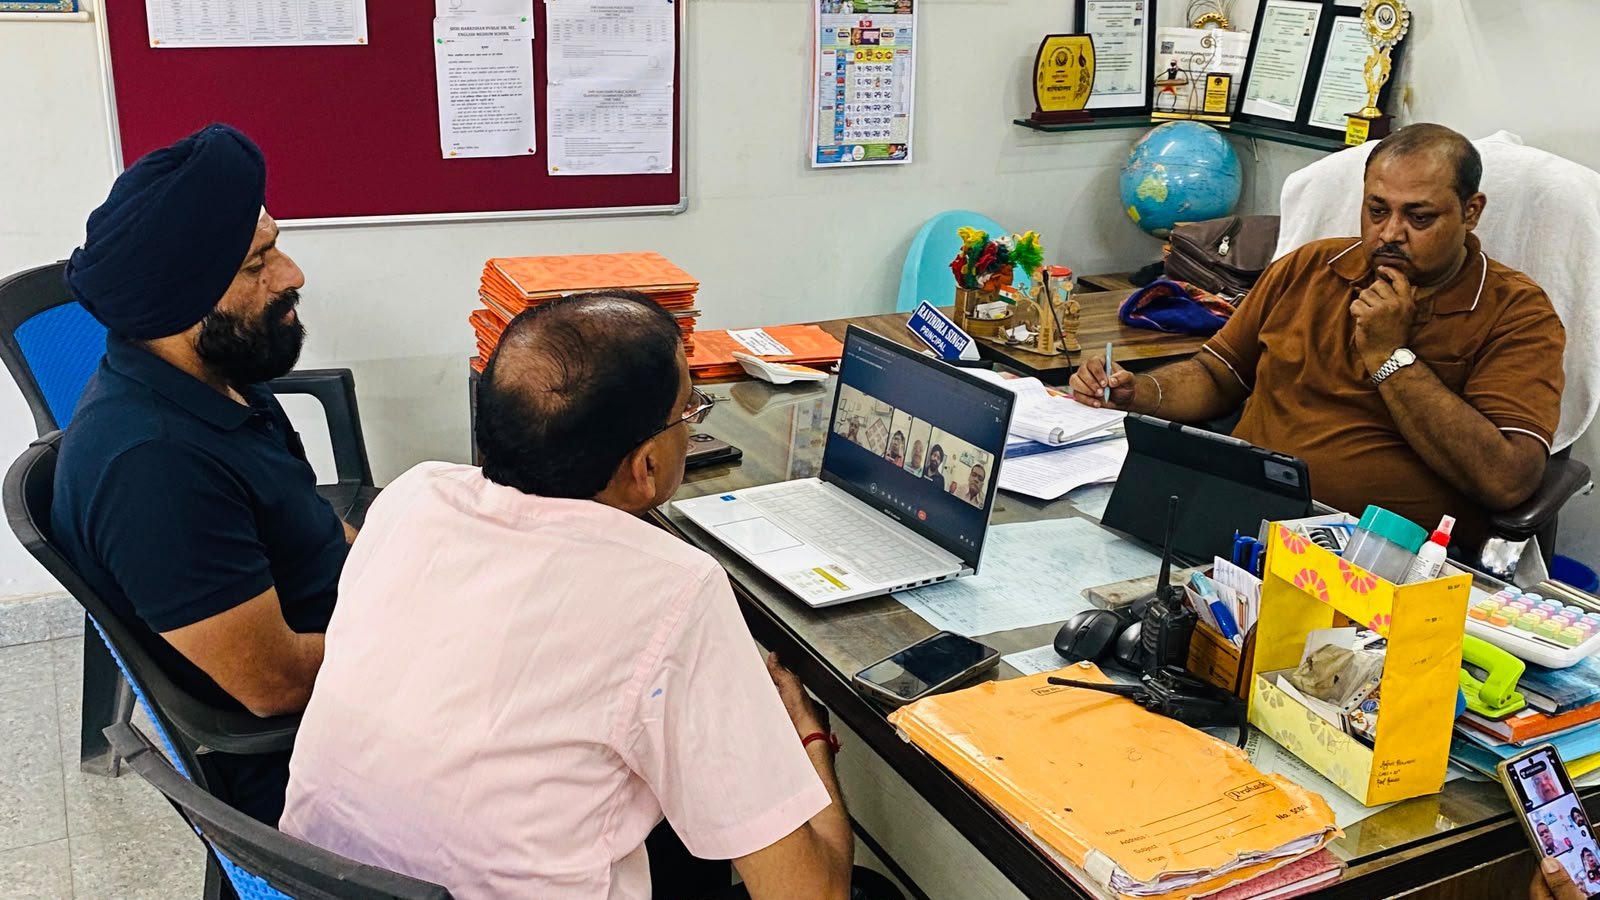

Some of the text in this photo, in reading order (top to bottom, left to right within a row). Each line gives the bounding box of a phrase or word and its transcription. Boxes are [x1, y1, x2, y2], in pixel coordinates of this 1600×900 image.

[917, 305, 967, 351] RAVINDRA SINGH
[920, 325, 946, 352] PRINCIPAL
